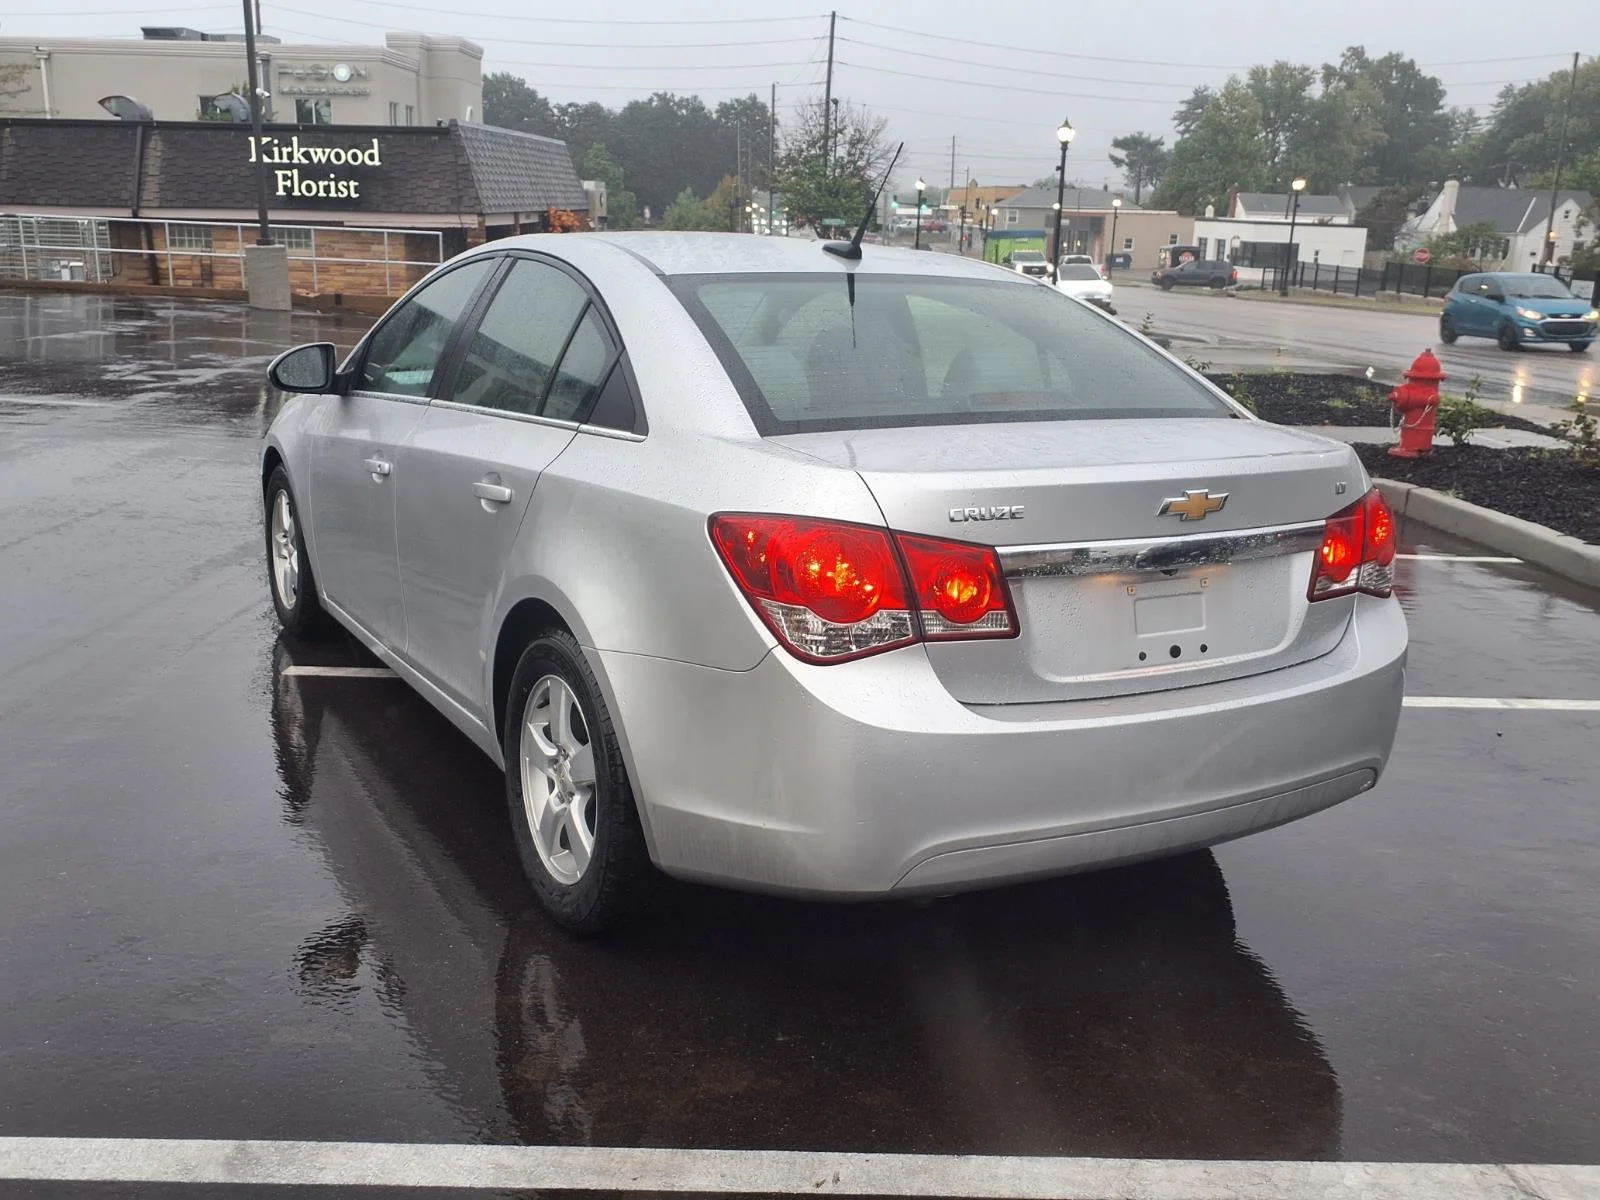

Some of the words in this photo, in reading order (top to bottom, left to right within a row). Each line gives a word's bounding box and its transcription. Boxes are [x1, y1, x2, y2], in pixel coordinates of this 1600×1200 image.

[248, 136, 382, 167] Kirkwood
[274, 168, 360, 198] Florist
[949, 505, 1025, 523] CRUZE
